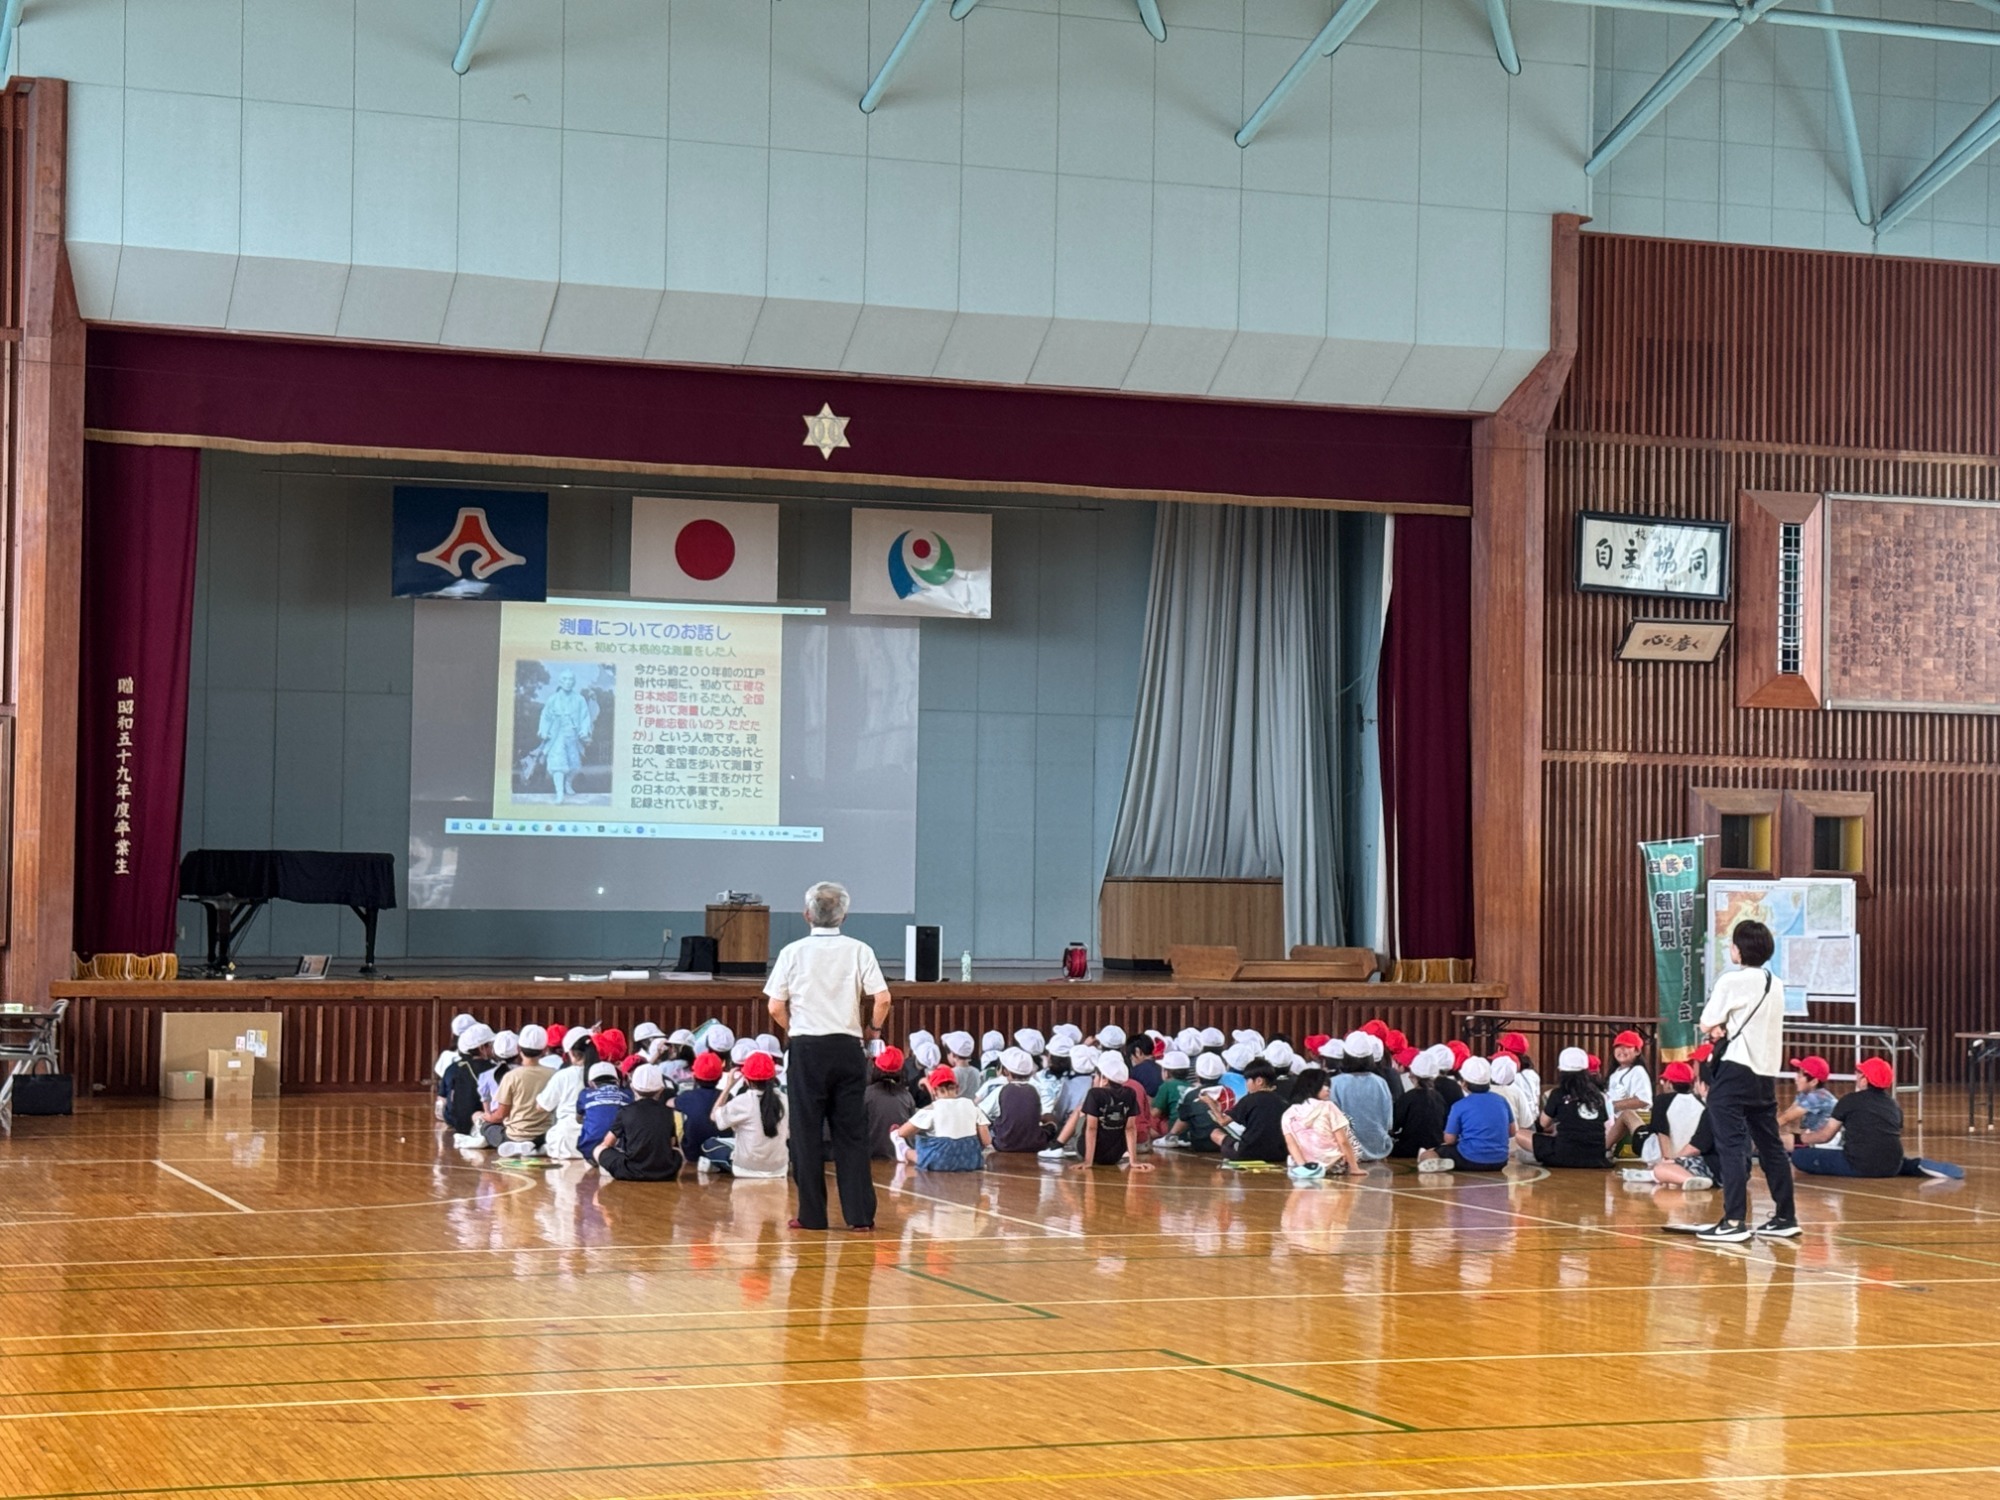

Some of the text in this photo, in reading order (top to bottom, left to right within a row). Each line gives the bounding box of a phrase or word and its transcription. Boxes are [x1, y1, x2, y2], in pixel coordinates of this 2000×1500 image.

[559, 618, 732, 641] 測量についてのお話し
